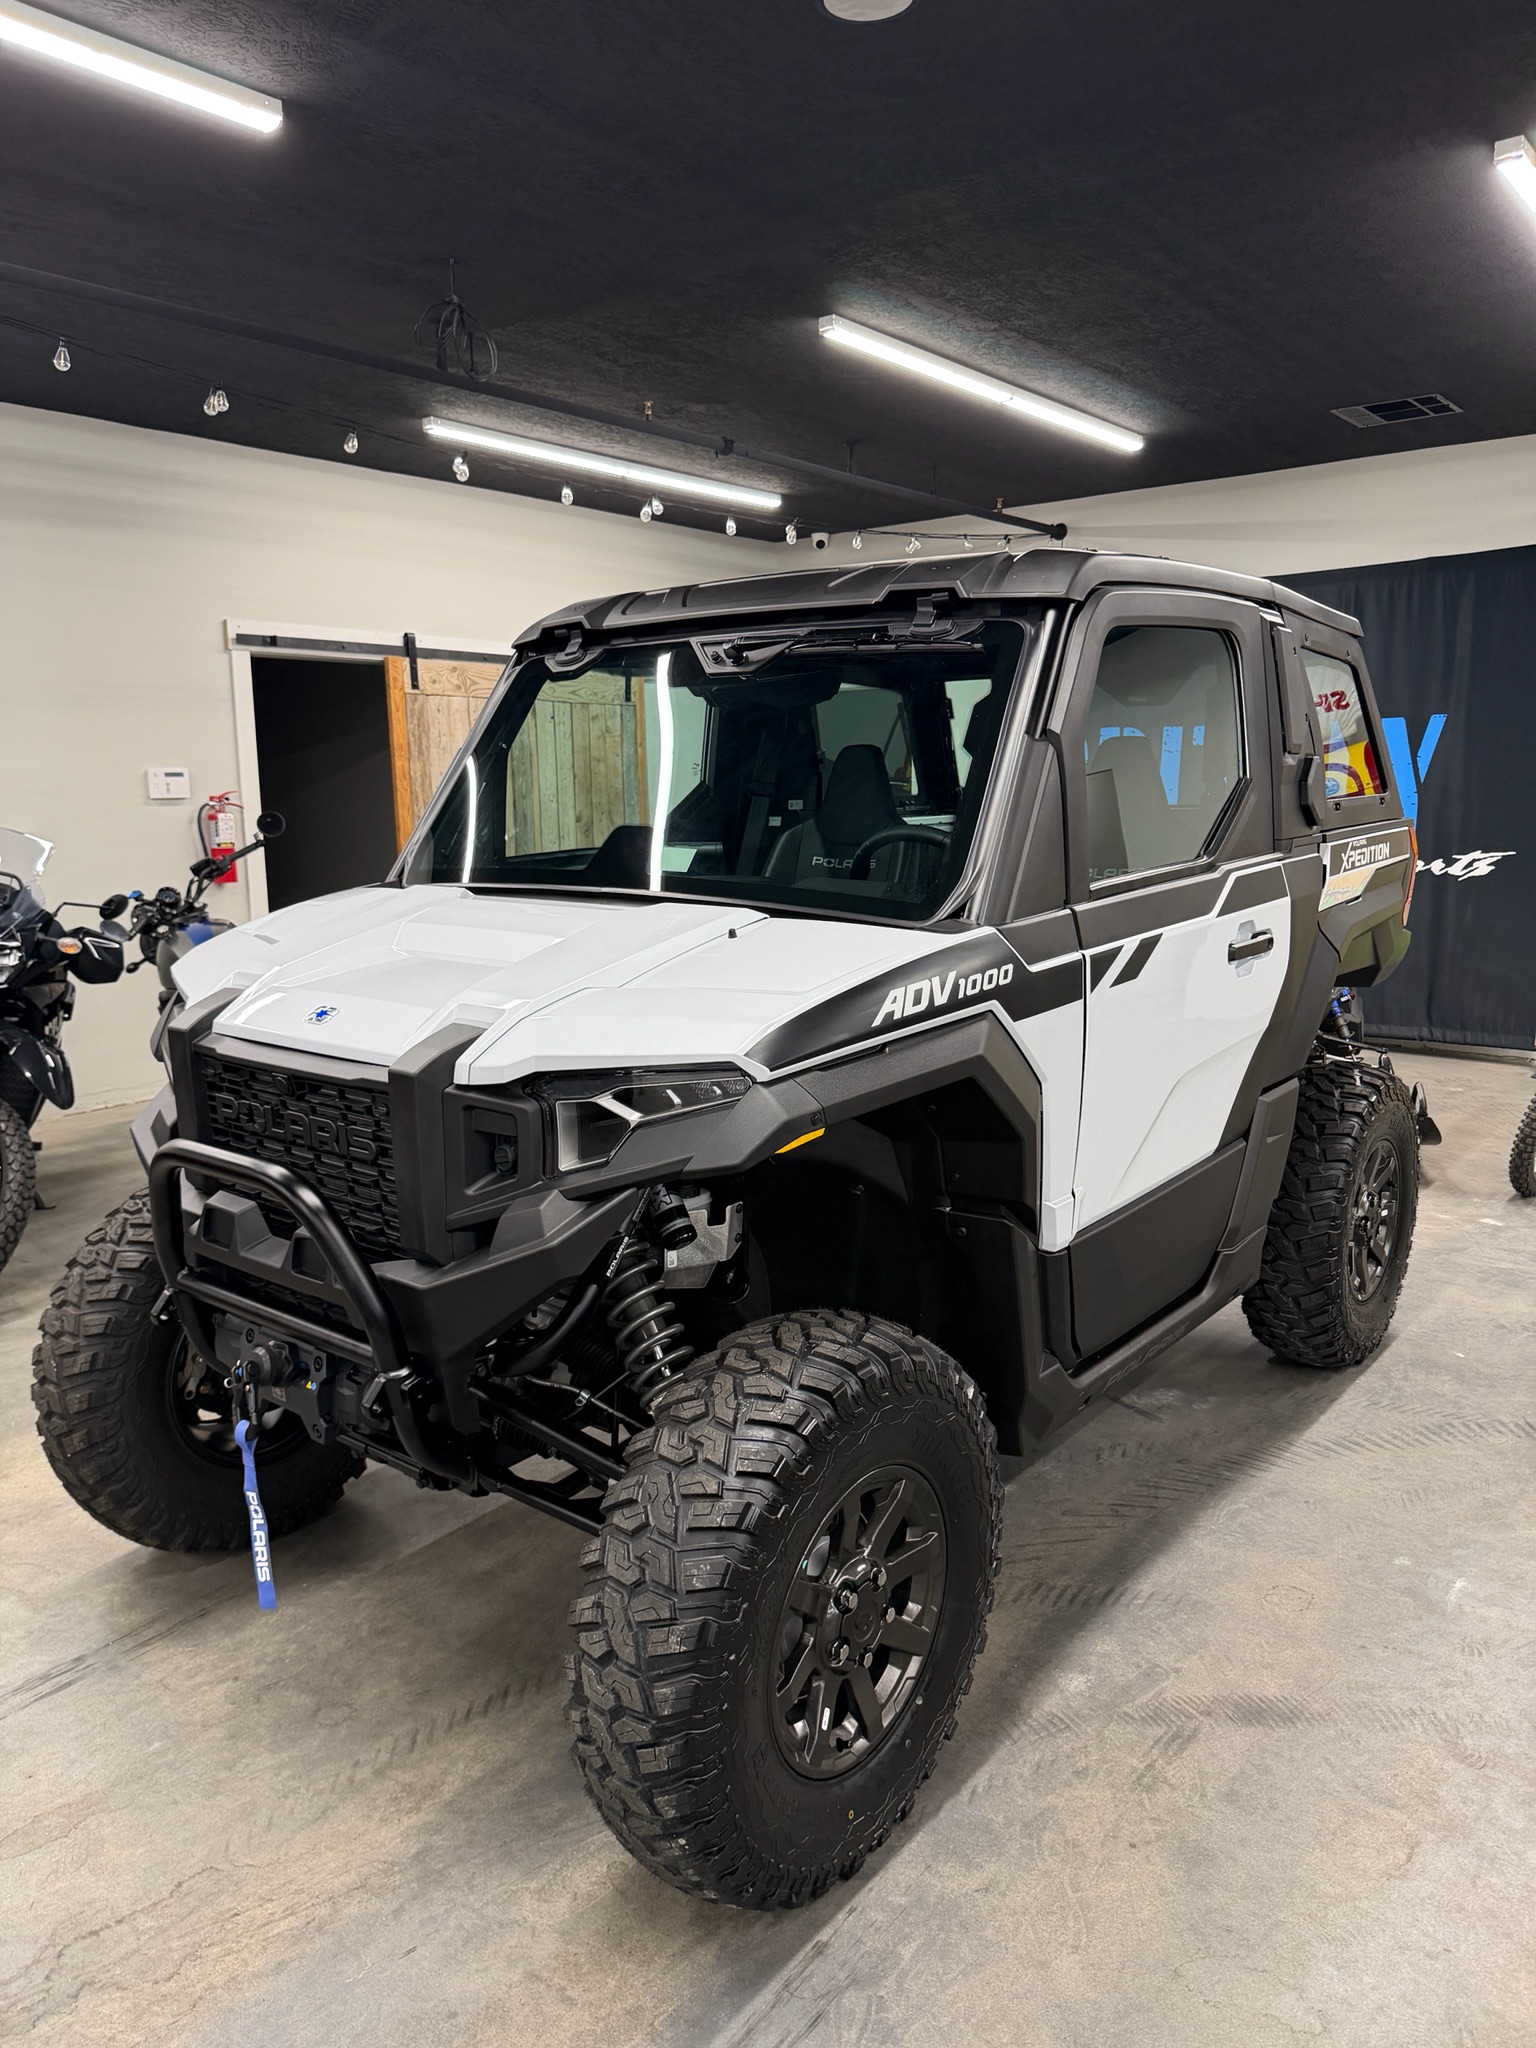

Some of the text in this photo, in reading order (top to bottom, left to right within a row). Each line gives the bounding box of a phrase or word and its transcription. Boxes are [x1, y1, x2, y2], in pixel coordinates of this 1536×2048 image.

[812, 856, 877, 869] POLAS
[1341, 842, 1390, 873] XPEDITION
[871, 963, 1014, 1027] ADV 1000
[214, 1092, 378, 1163] POLARIS
[245, 1490, 271, 1583] POLARIS
